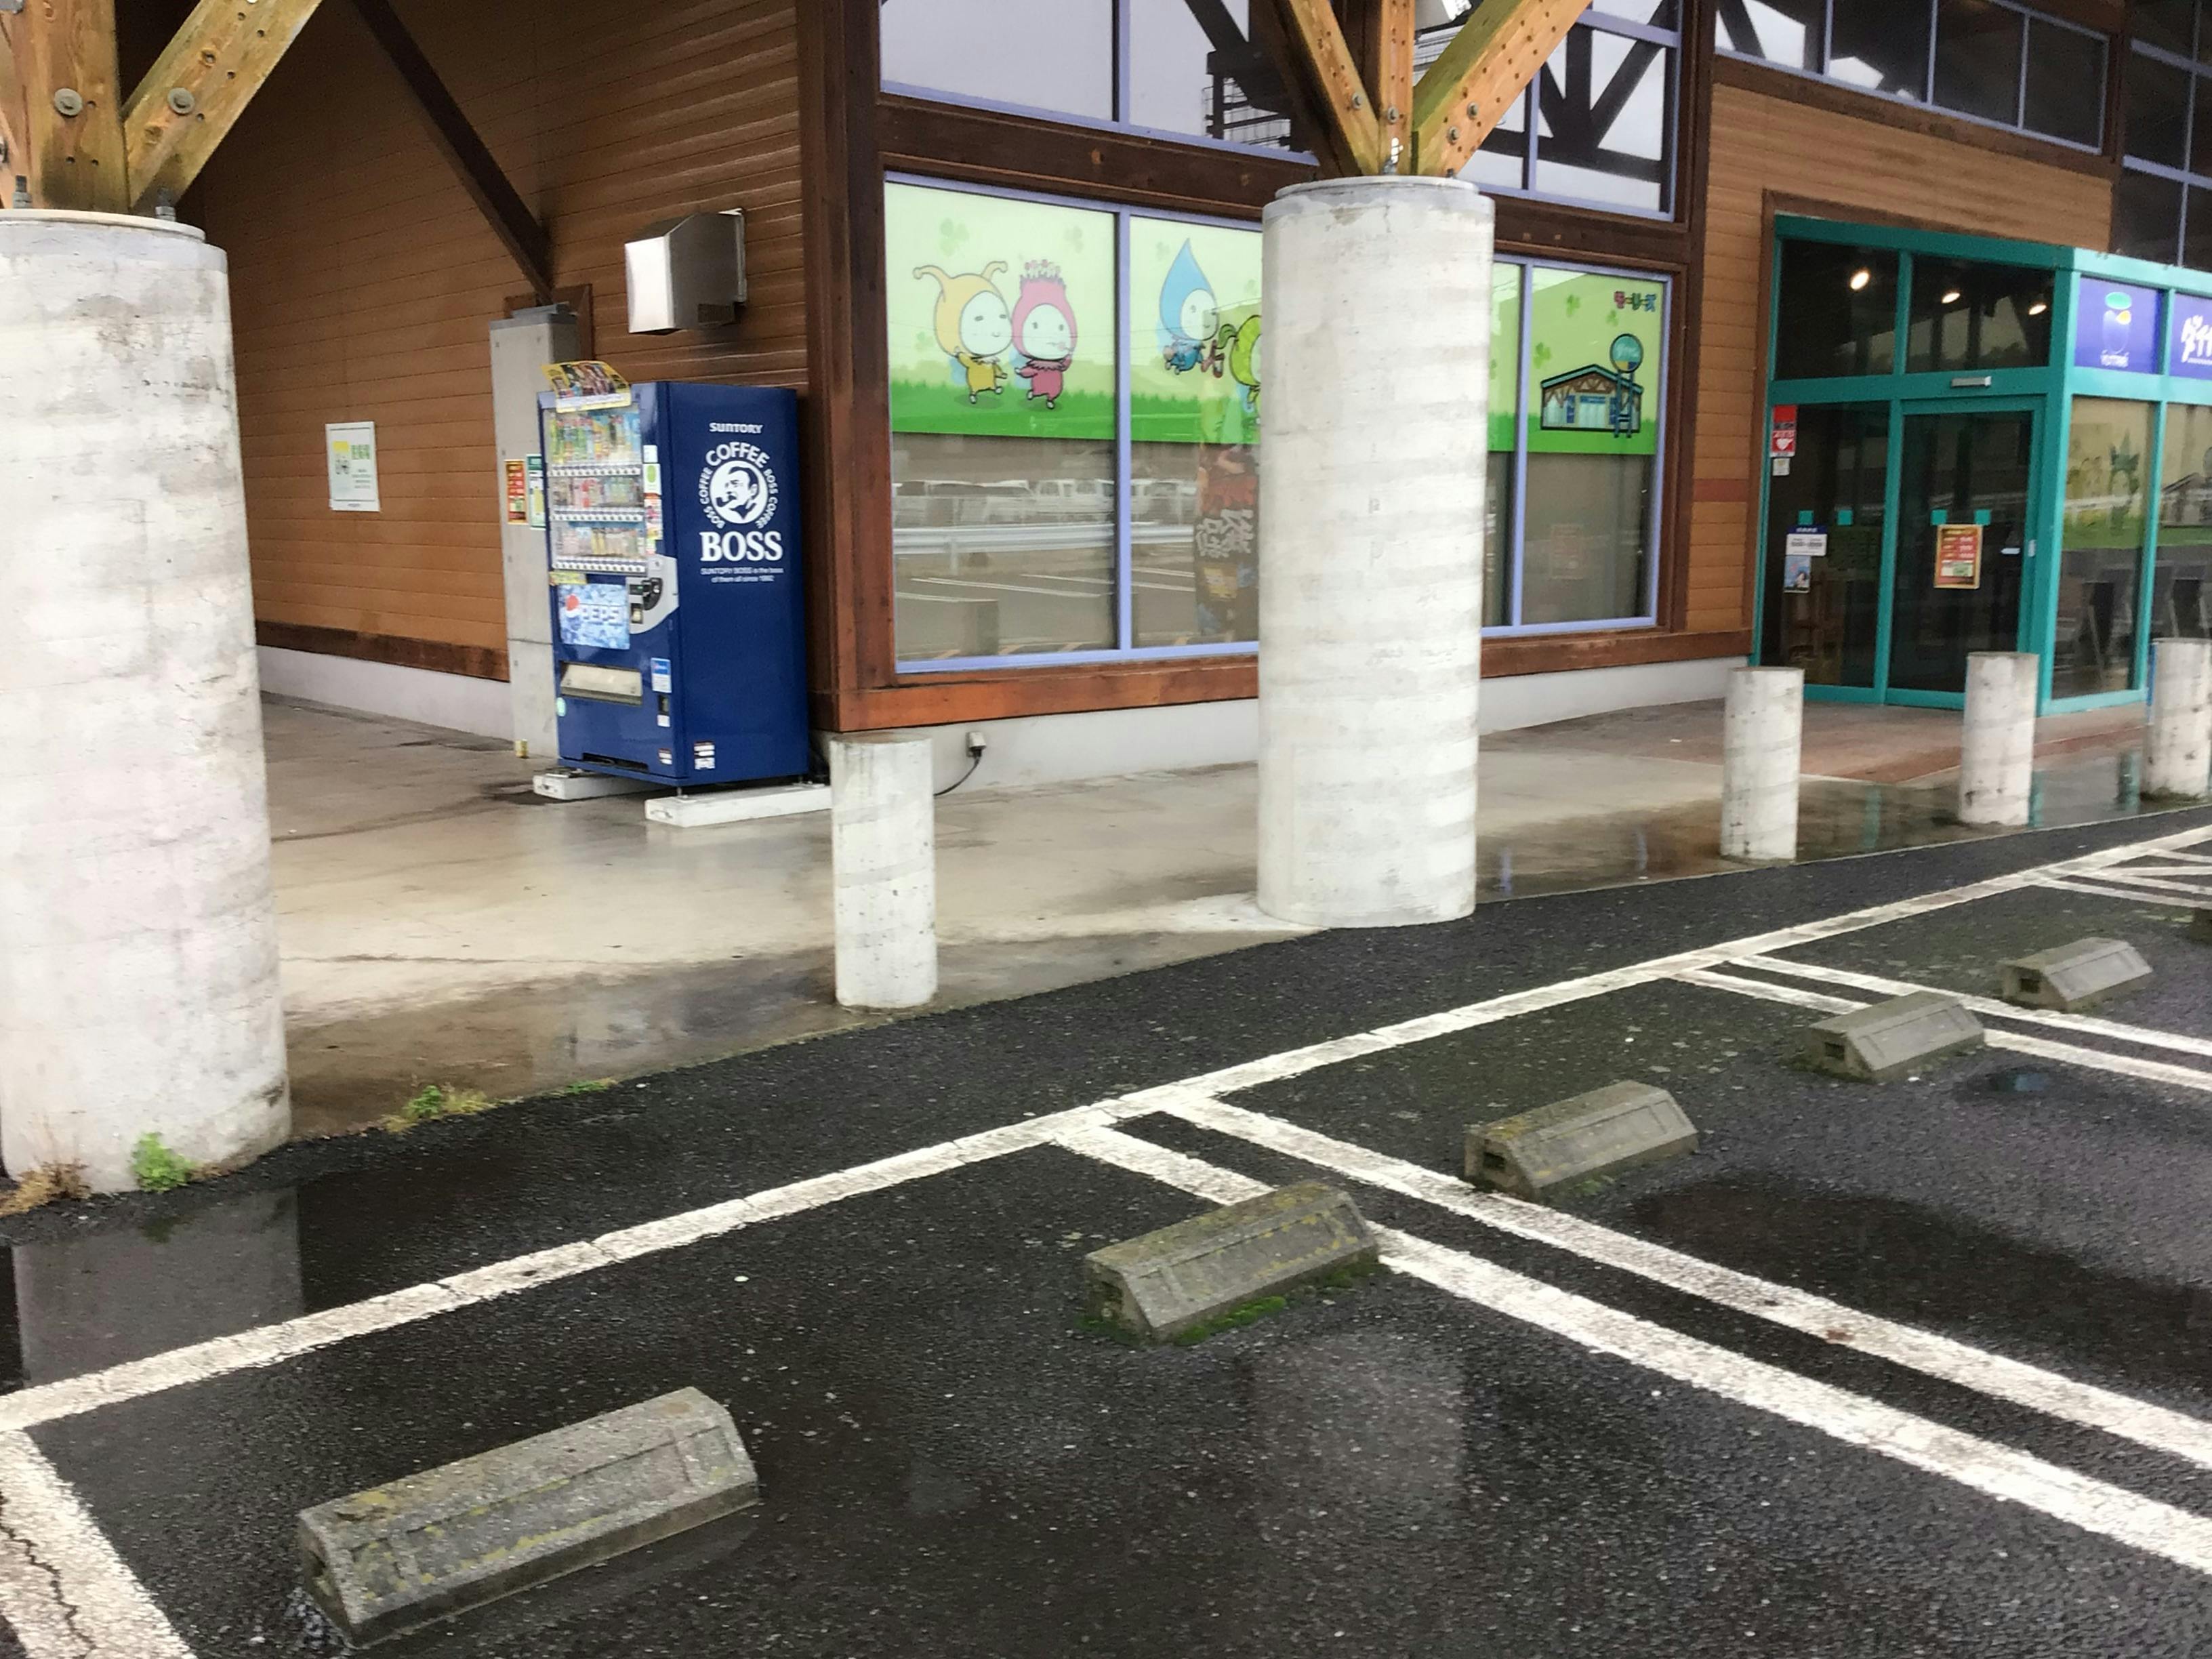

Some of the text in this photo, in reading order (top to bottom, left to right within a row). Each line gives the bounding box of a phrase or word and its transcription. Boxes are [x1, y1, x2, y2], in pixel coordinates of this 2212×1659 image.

[705, 442, 770, 468] COFFEE
[699, 467, 726, 529] BOSS COFFEE
[755, 468, 779, 529] BOSS COFFEE
[699, 531, 783, 561] BOSS
